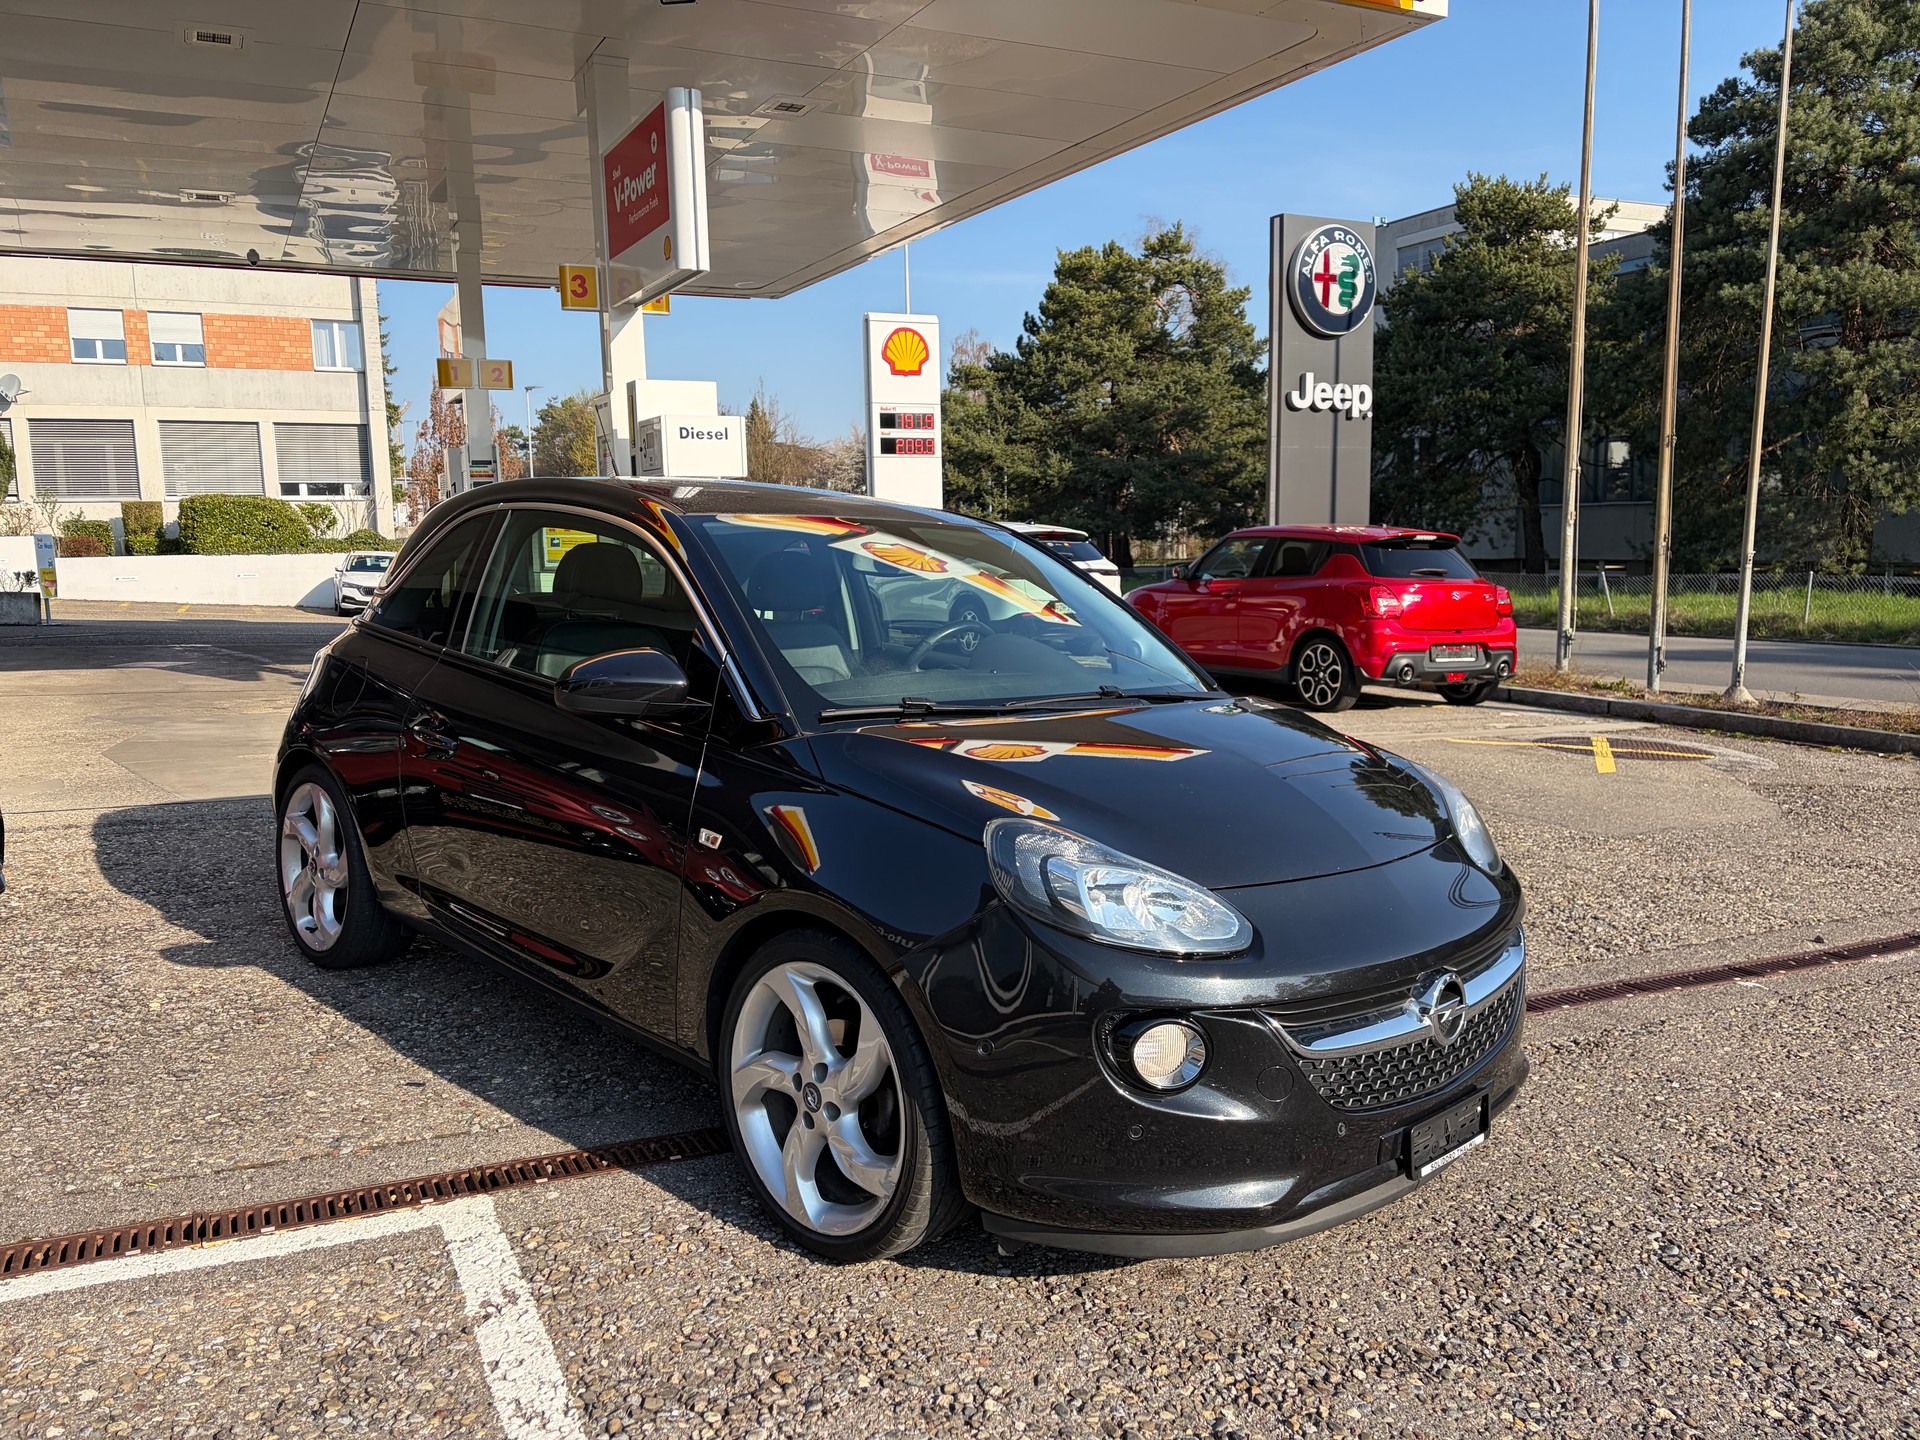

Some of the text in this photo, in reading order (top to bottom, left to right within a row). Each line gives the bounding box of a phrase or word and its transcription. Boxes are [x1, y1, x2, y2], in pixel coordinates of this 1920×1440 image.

[613, 161, 657, 213] V-Power
[1301, 230, 1373, 284] ALFA ROMEO
[570, 273, 589, 299] 3
[450, 365, 459, 381] 1
[490, 367, 504, 383] 2
[1291, 371, 1373, 418] Jeep
[679, 426, 728, 440] Diesel
[896, 438, 935, 455] 209.9
